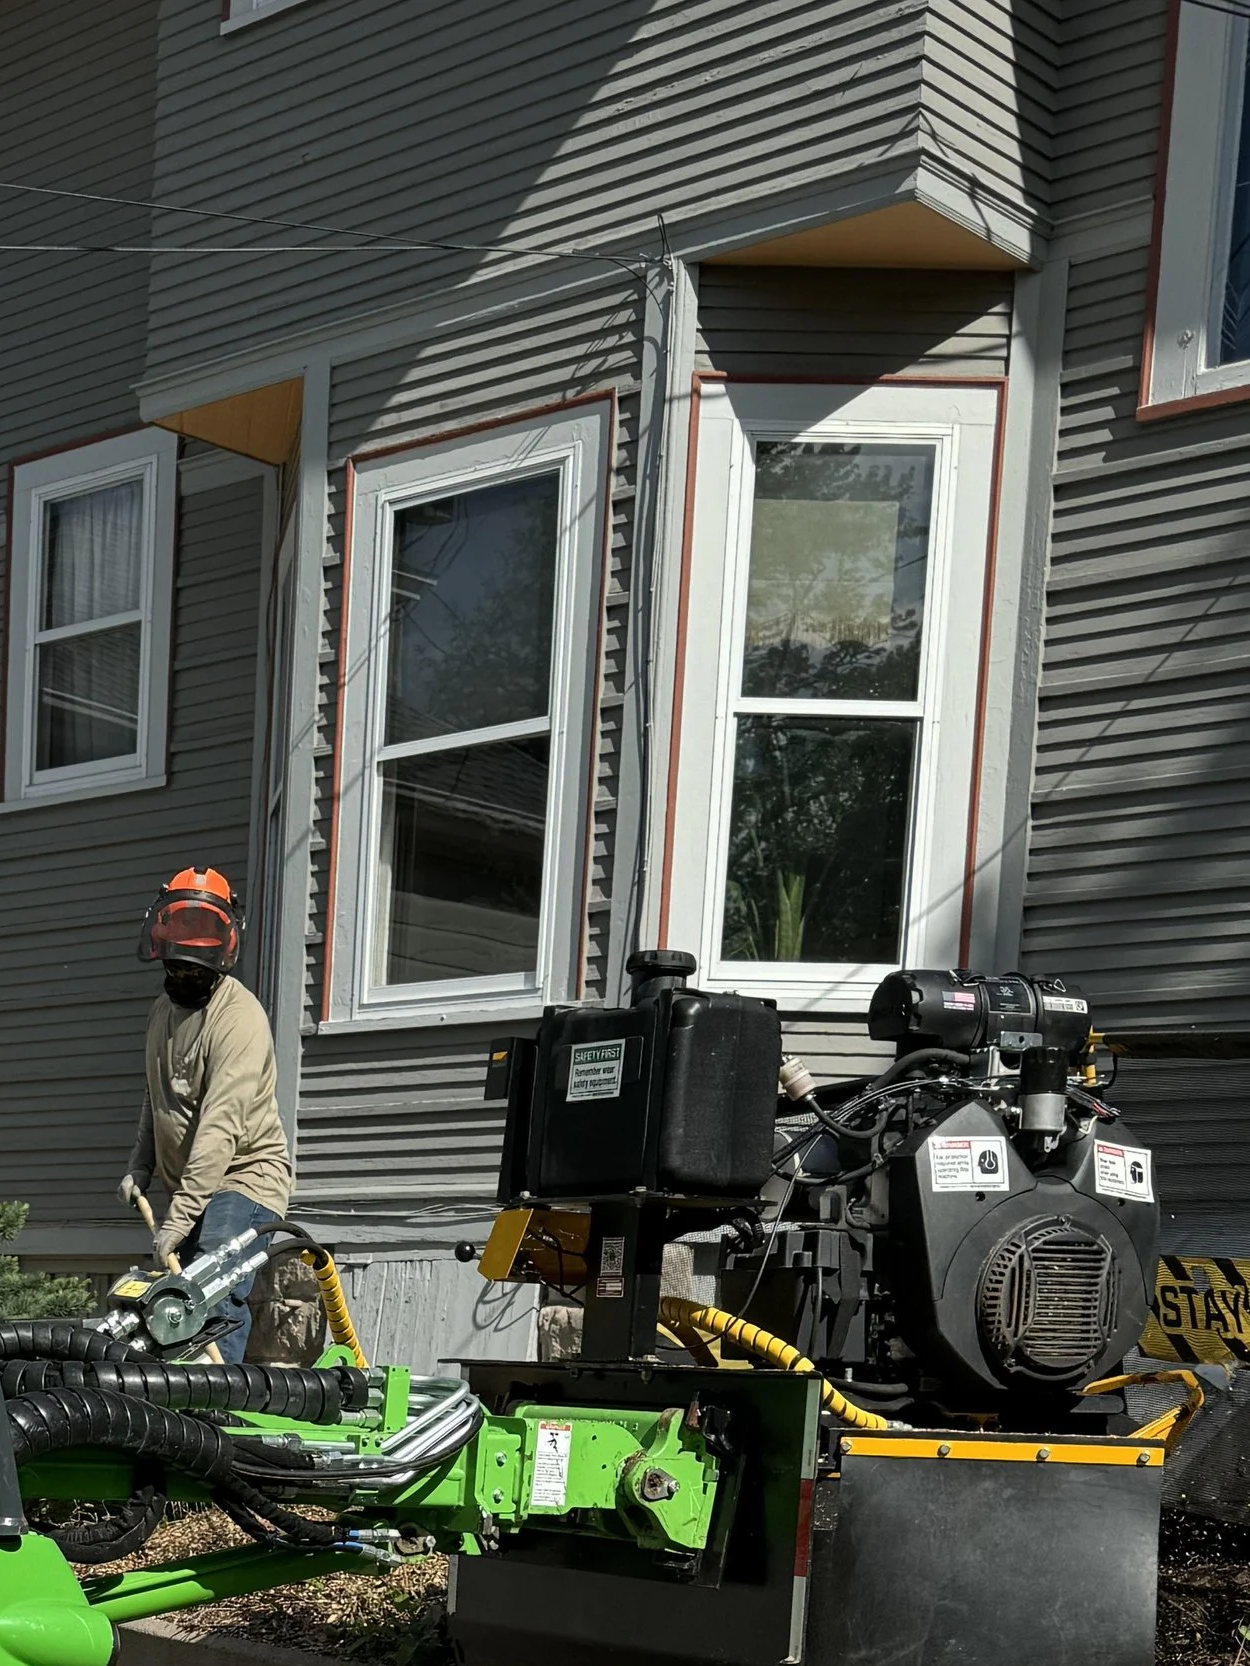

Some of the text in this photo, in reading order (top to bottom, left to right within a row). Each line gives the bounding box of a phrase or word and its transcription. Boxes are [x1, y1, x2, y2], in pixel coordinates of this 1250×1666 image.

[575, 1047, 620, 1062] SAFETY FIRST
[1160, 1285, 1243, 1334] STAY
